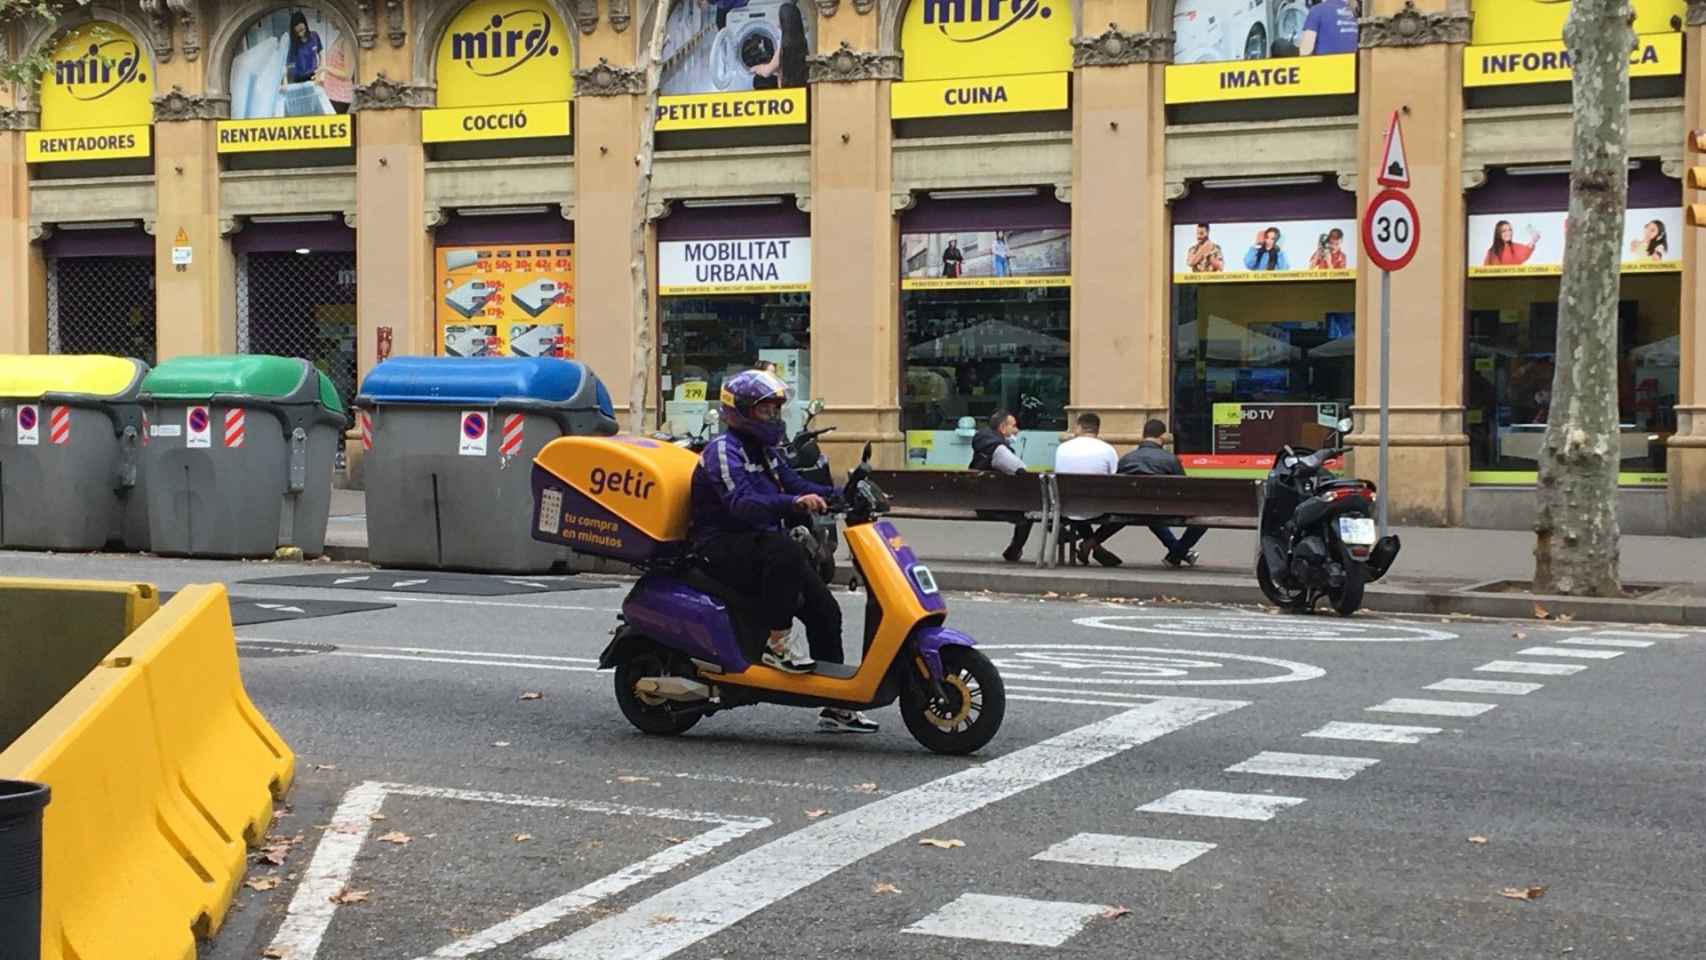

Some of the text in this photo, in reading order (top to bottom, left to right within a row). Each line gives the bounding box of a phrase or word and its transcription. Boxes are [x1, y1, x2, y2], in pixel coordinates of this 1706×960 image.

[1220, 66, 1300, 89] IMATGE
[944, 86, 1008, 106] CUINA
[656, 98, 795, 122] PETIT ELECTRO
[463, 110, 528, 132] COCCIÓ
[39, 134, 136, 153] RENTADORES
[220, 123, 348, 144] RENTAVAIXELLES
[1377, 216, 1409, 243] 30
[684, 240, 791, 262] MOBILITAT
[696, 262, 780, 283] URBANA
[1259, 409, 1275, 420] TV
[589, 467, 656, 500] getir
[564, 512, 619, 532] tu compra
[562, 528, 623, 548] en minutos
